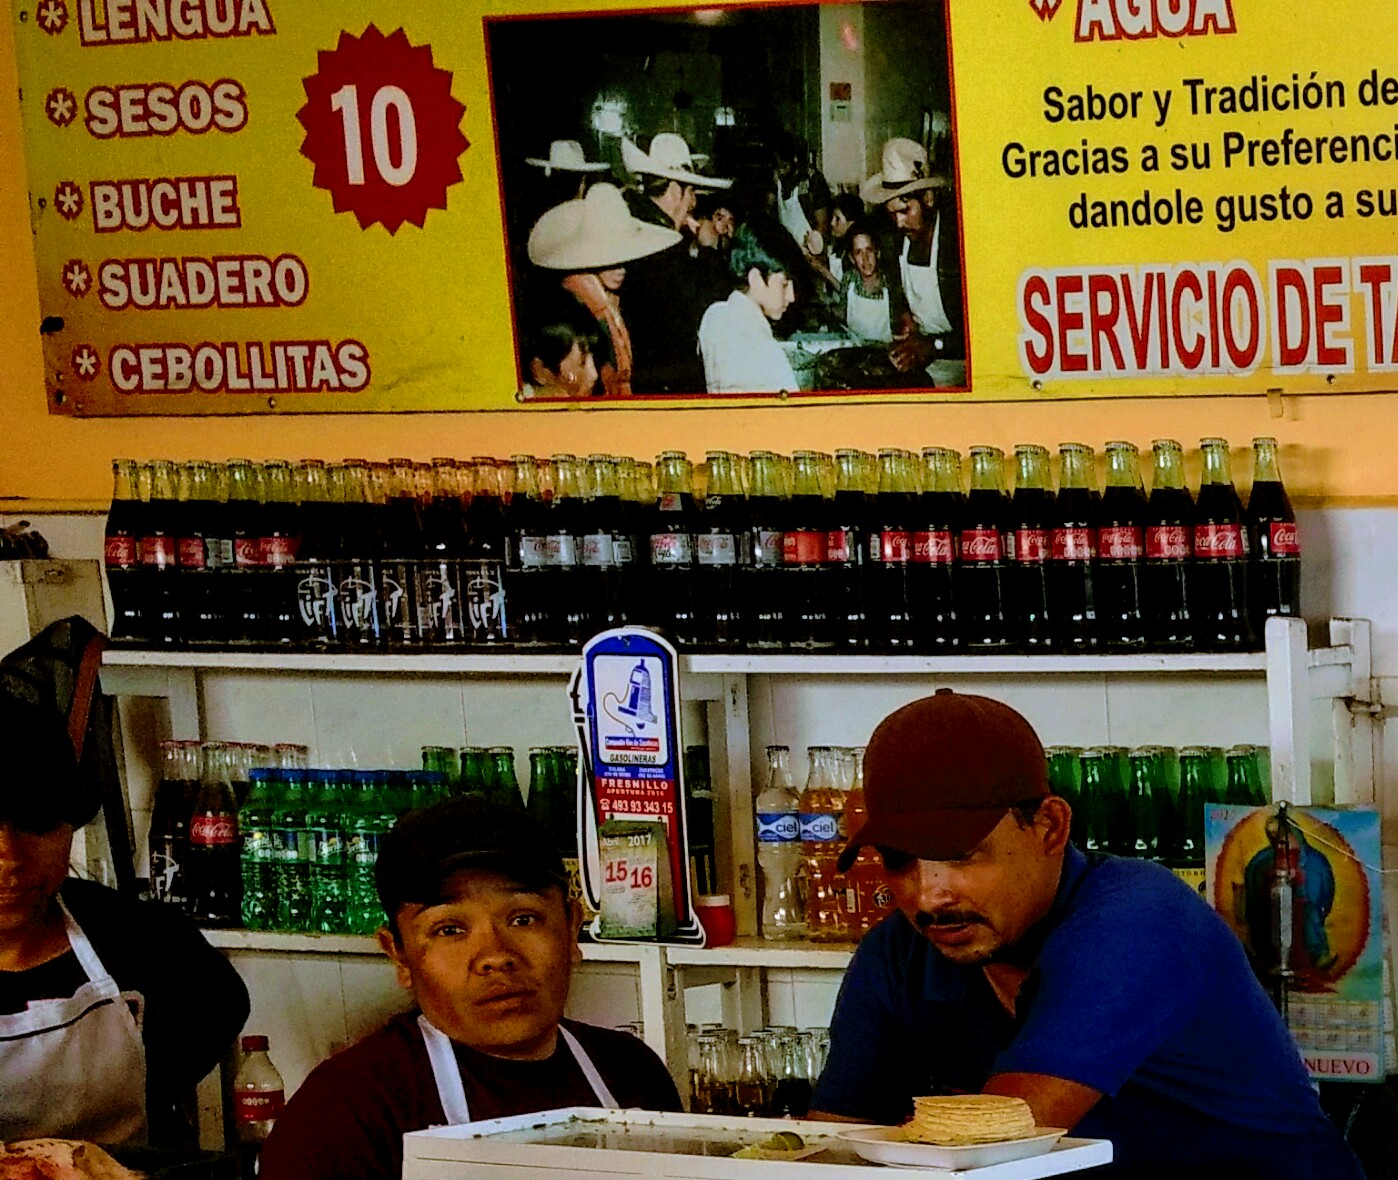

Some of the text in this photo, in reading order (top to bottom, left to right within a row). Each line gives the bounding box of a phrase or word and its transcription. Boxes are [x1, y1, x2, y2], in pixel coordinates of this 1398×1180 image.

[78, 0, 275, 45] LENGUA
[1076, 0, 1236, 41] AGUA
[86, 80, 246, 137] SESOS
[1043, 86, 1143, 123] Sabor
[1152, 89, 1173, 127] y
[1183, 70, 1347, 115] Tradición
[330, 84, 419, 187] 10
[1001, 138, 1130, 179] Gracias
[1141, 144, 1161, 172] a
[1170, 141, 1211, 171] su
[93, 177, 238, 232] BUCHE
[1068, 188, 1203, 230] dandole
[1215, 185, 1314, 232] gusto
[1324, 193, 1345, 219] a
[1357, 189, 1398, 218] su
[99, 256, 309, 309] SUADERO
[1021, 266, 1257, 375] SERVICIO
[1278, 264, 1347, 368] DE
[110, 343, 370, 395] CEBOLLITAS
[609, 754, 656, 763] GASOLINERAS
[601, 778, 668, 790] FRESNILLO
[606, 788, 645, 796] APERTURA
[612, 799, 673, 814] 493 93 343 15
[775, 821, 798, 833] ciel
[812, 821, 834, 833] ciel
[628, 833, 652, 847] 2017
[606, 861, 627, 882] 15
[631, 866, 652, 888] 16
[1304, 1057, 1370, 1076] NUEVO
